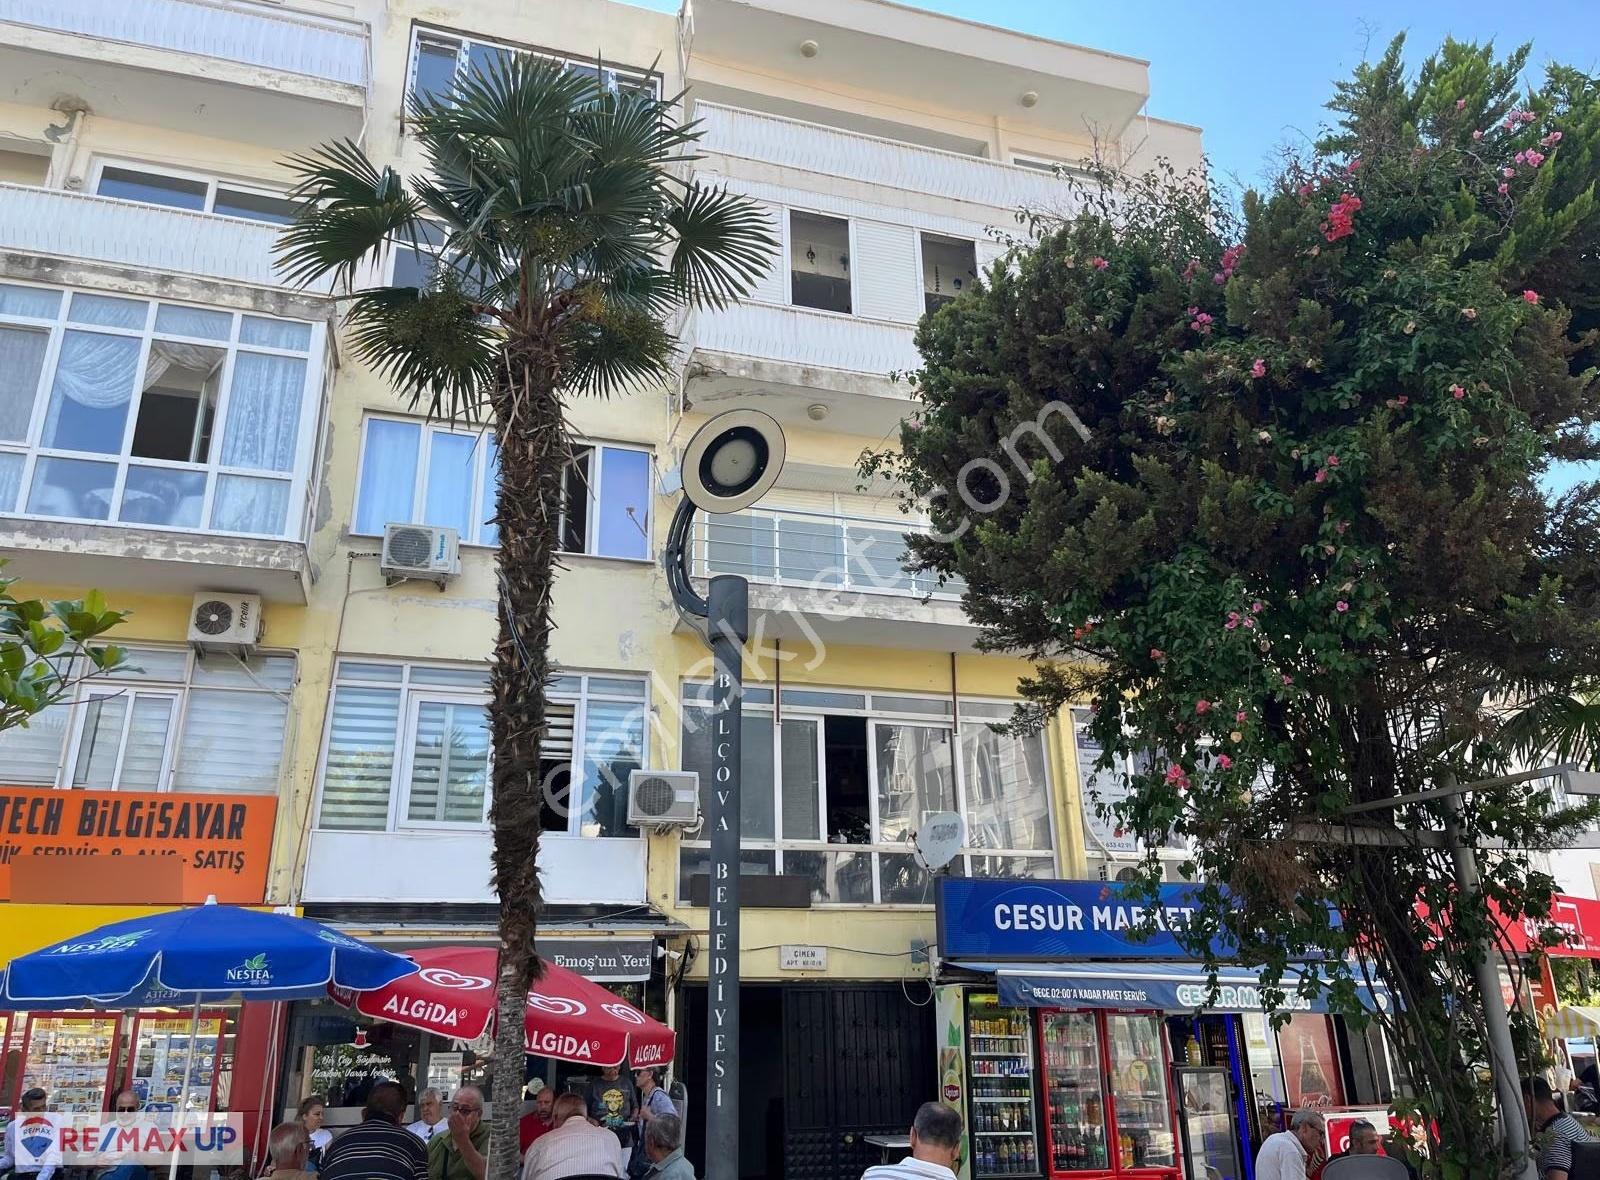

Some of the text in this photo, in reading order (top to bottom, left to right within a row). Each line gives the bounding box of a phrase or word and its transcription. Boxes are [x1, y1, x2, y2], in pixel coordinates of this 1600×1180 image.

[716, 673, 731, 831] BALÇOVA
[193, 850, 245, 873] SATIŞ
[994, 903, 1084, 932] CESUR
[554, 954, 650, 971] Emoş'un Yeri
[227, 969, 270, 980] NESTEA
[1079, 989, 1102, 1000] KADAR
[1103, 990, 1123, 1001] PAKET
[1123, 989, 1147, 1001] SERVİS
